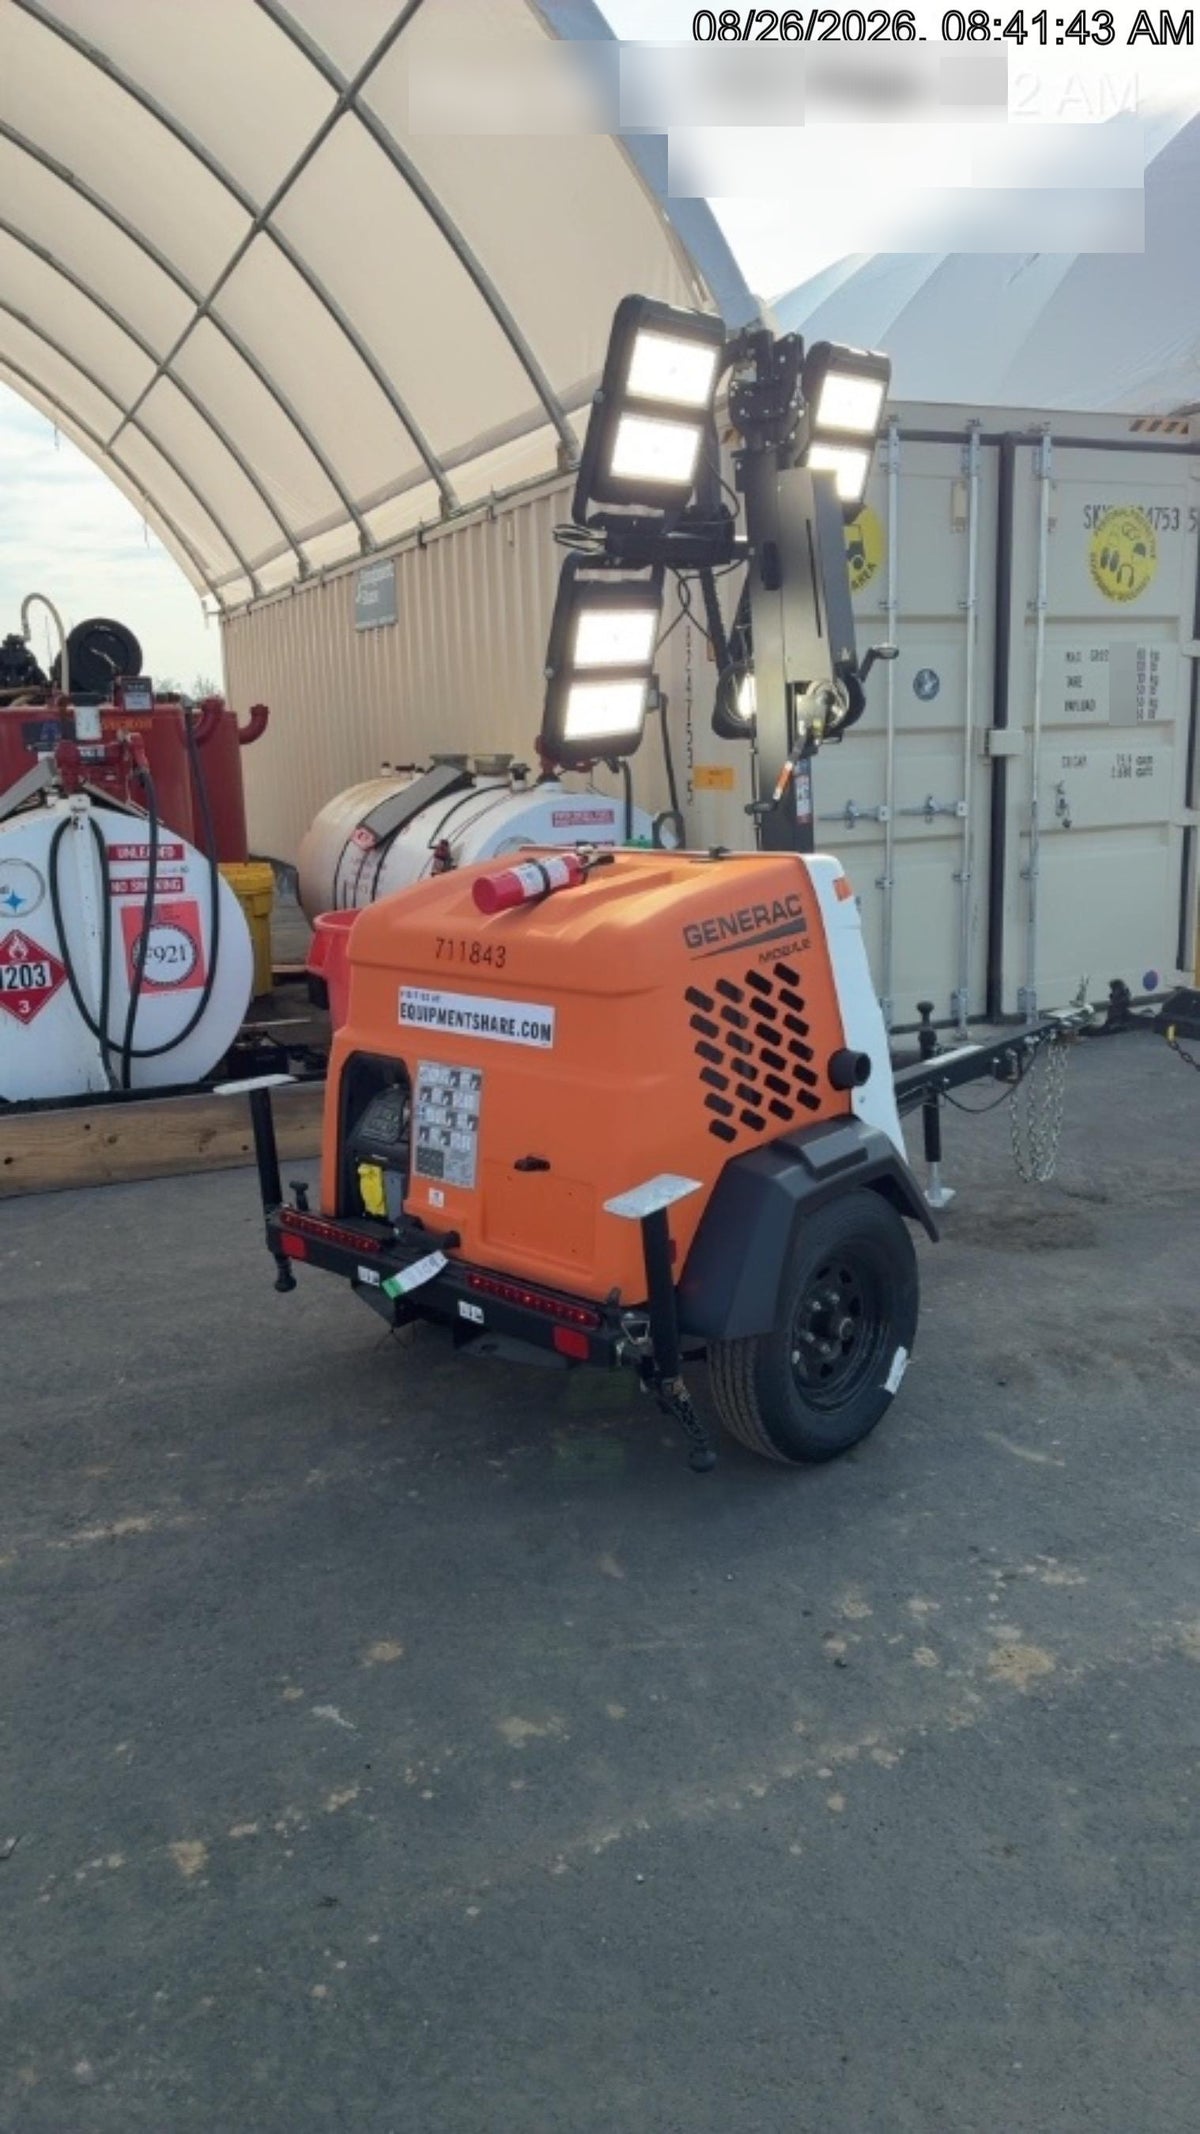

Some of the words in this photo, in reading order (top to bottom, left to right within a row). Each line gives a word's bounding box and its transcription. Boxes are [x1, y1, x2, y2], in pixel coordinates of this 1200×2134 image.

[117, 845, 175, 860] UNLEED
[130, 878, 182, 893] SMKING
[683, 894, 802, 949] GENERAC
[435, 937, 507, 969] 711843
[19, 1000, 31, 1014] 3
[399, 1002, 551, 1042] EQUIPMENTSHARE.COM
